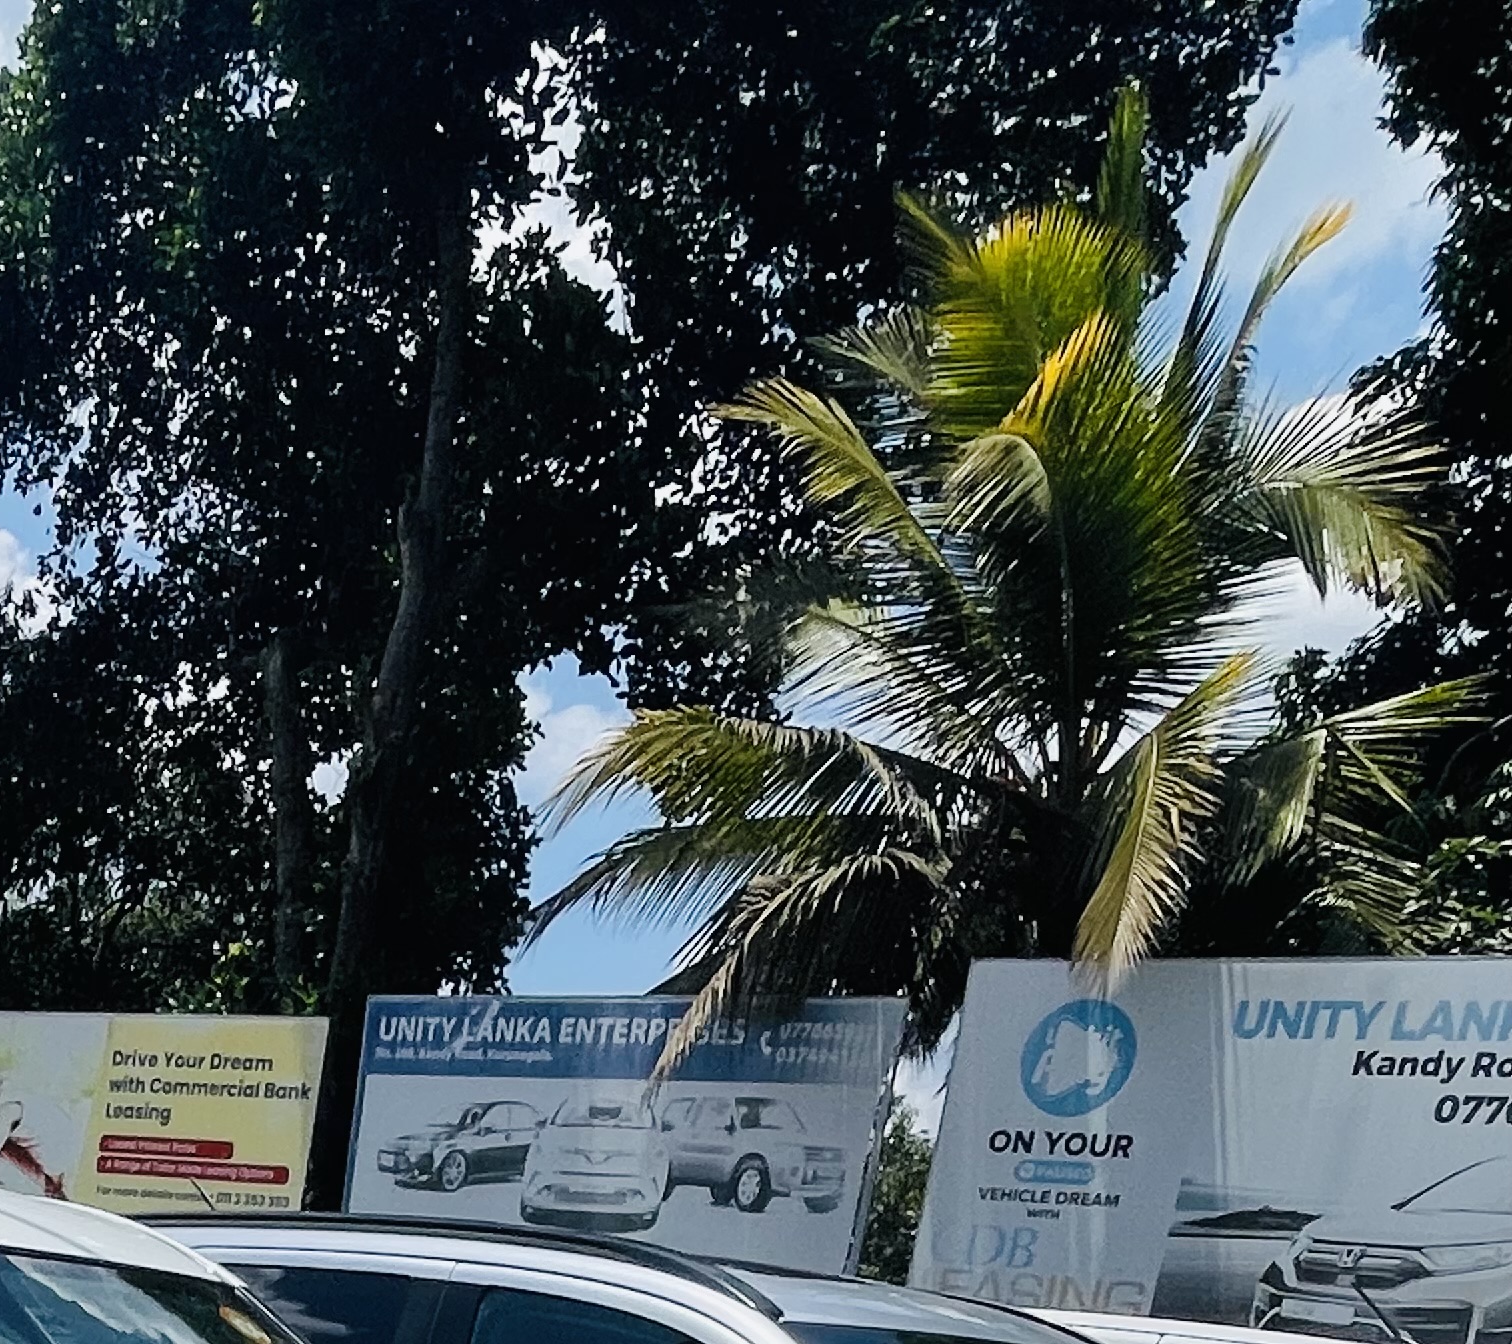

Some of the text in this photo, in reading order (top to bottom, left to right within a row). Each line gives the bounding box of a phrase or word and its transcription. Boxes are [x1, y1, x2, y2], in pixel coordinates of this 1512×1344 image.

[378, 1016, 746, 1047] UNITY LANKA ENTERPSES
[1232, 999, 1387, 1041] UNITY
[112, 1049, 274, 1071] Drive Your Dream
[1351, 1049, 1465, 1084] Kandy
[108, 1075, 312, 1101] with Commercial Bank
[105, 1102, 172, 1127] Leasing
[989, 1130, 1134, 1159] ON YOUR
[978, 1186, 1122, 1208] VEHICLE DREAM
